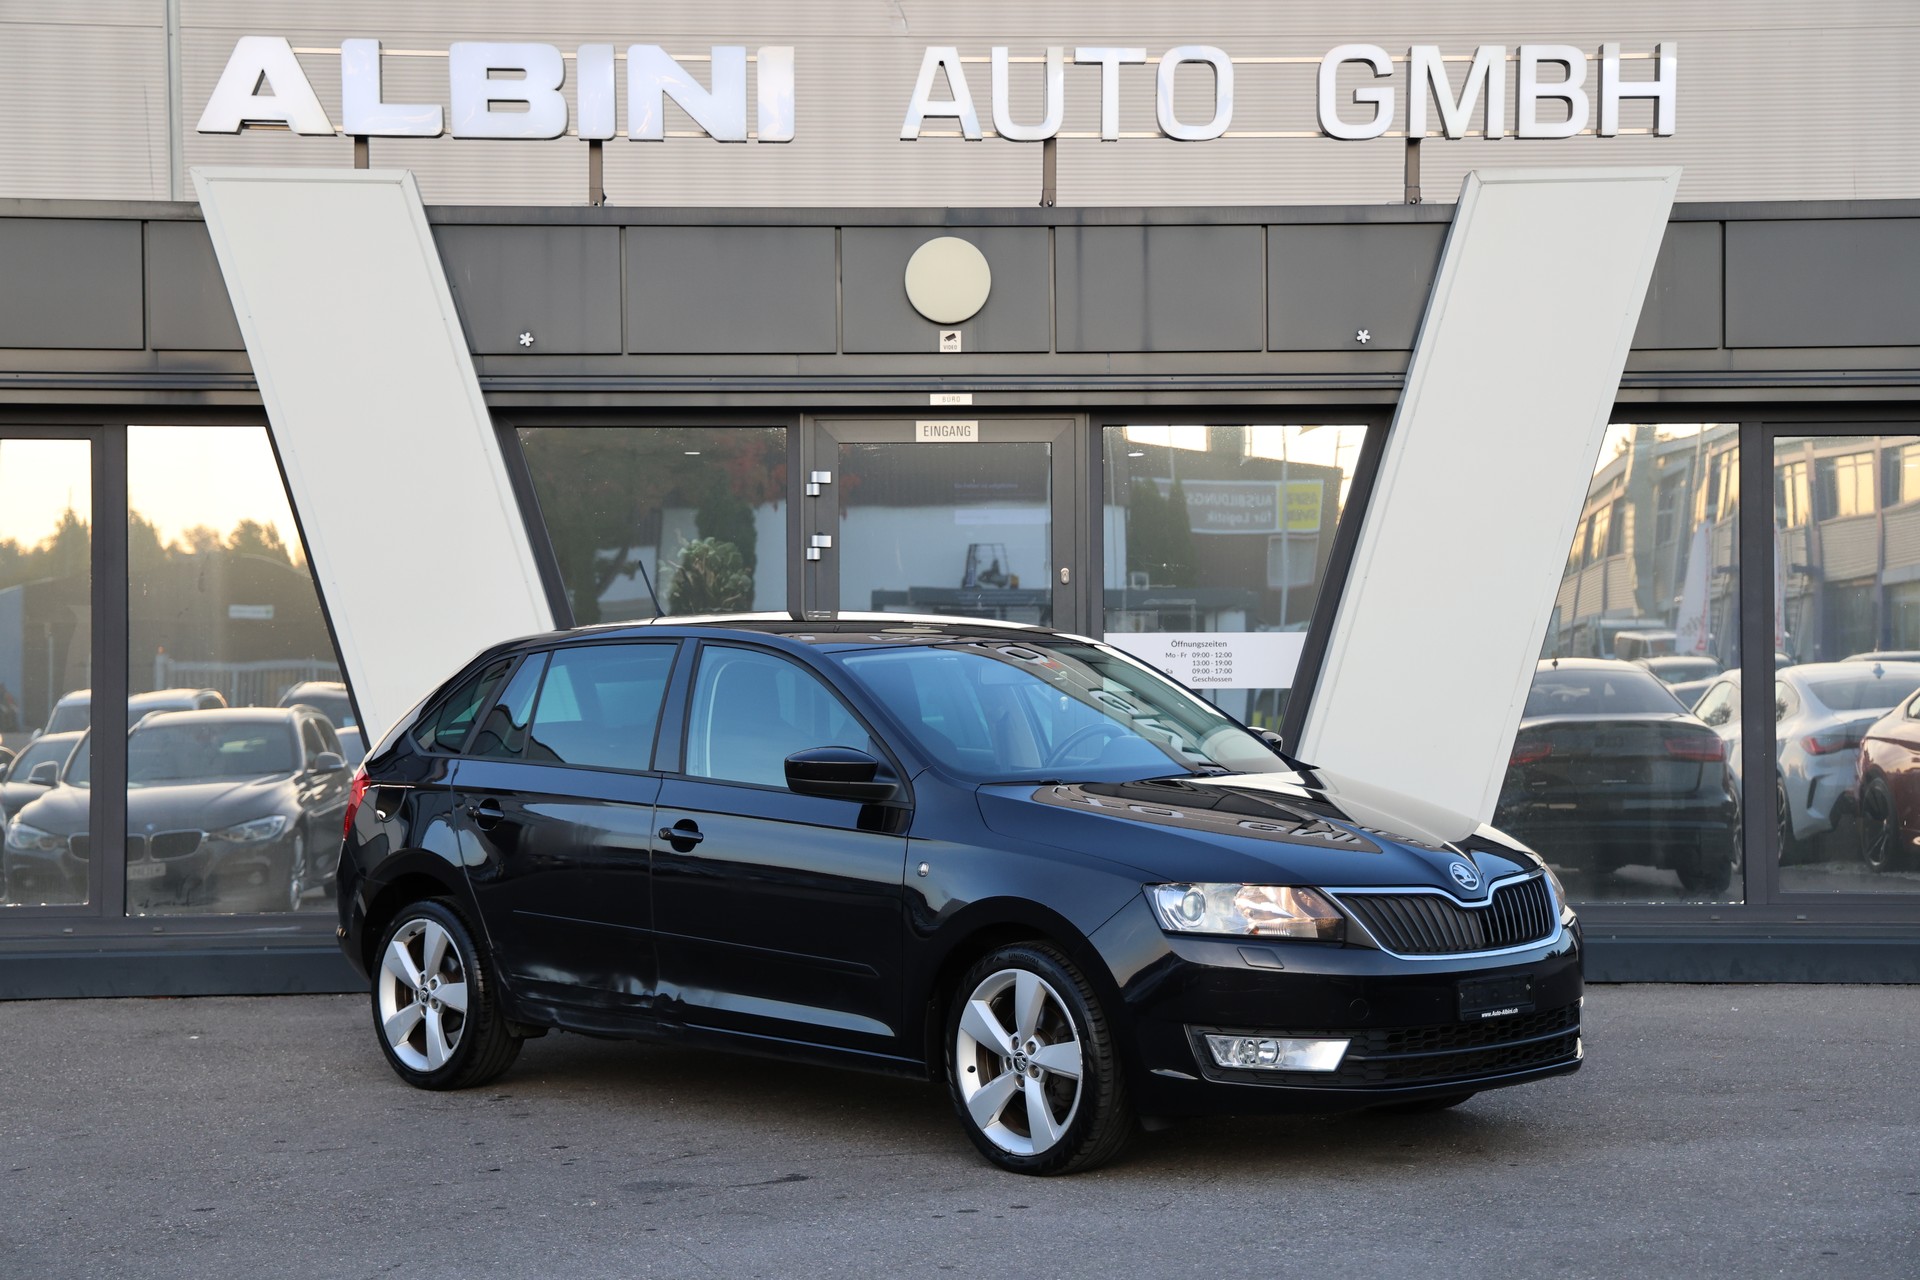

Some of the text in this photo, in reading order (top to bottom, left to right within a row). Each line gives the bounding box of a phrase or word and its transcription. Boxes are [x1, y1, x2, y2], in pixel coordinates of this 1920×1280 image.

[196, 36, 1678, 142] ALBINI AUTO GMBH
[923, 425, 971, 437] EINGANG
[1171, 640, 1227, 648] Öffnungszeiten
[1009, 953, 1039, 965] UNIROYAL
[1481, 1008, 1518, 1018] www.Auto-Albini.ch
